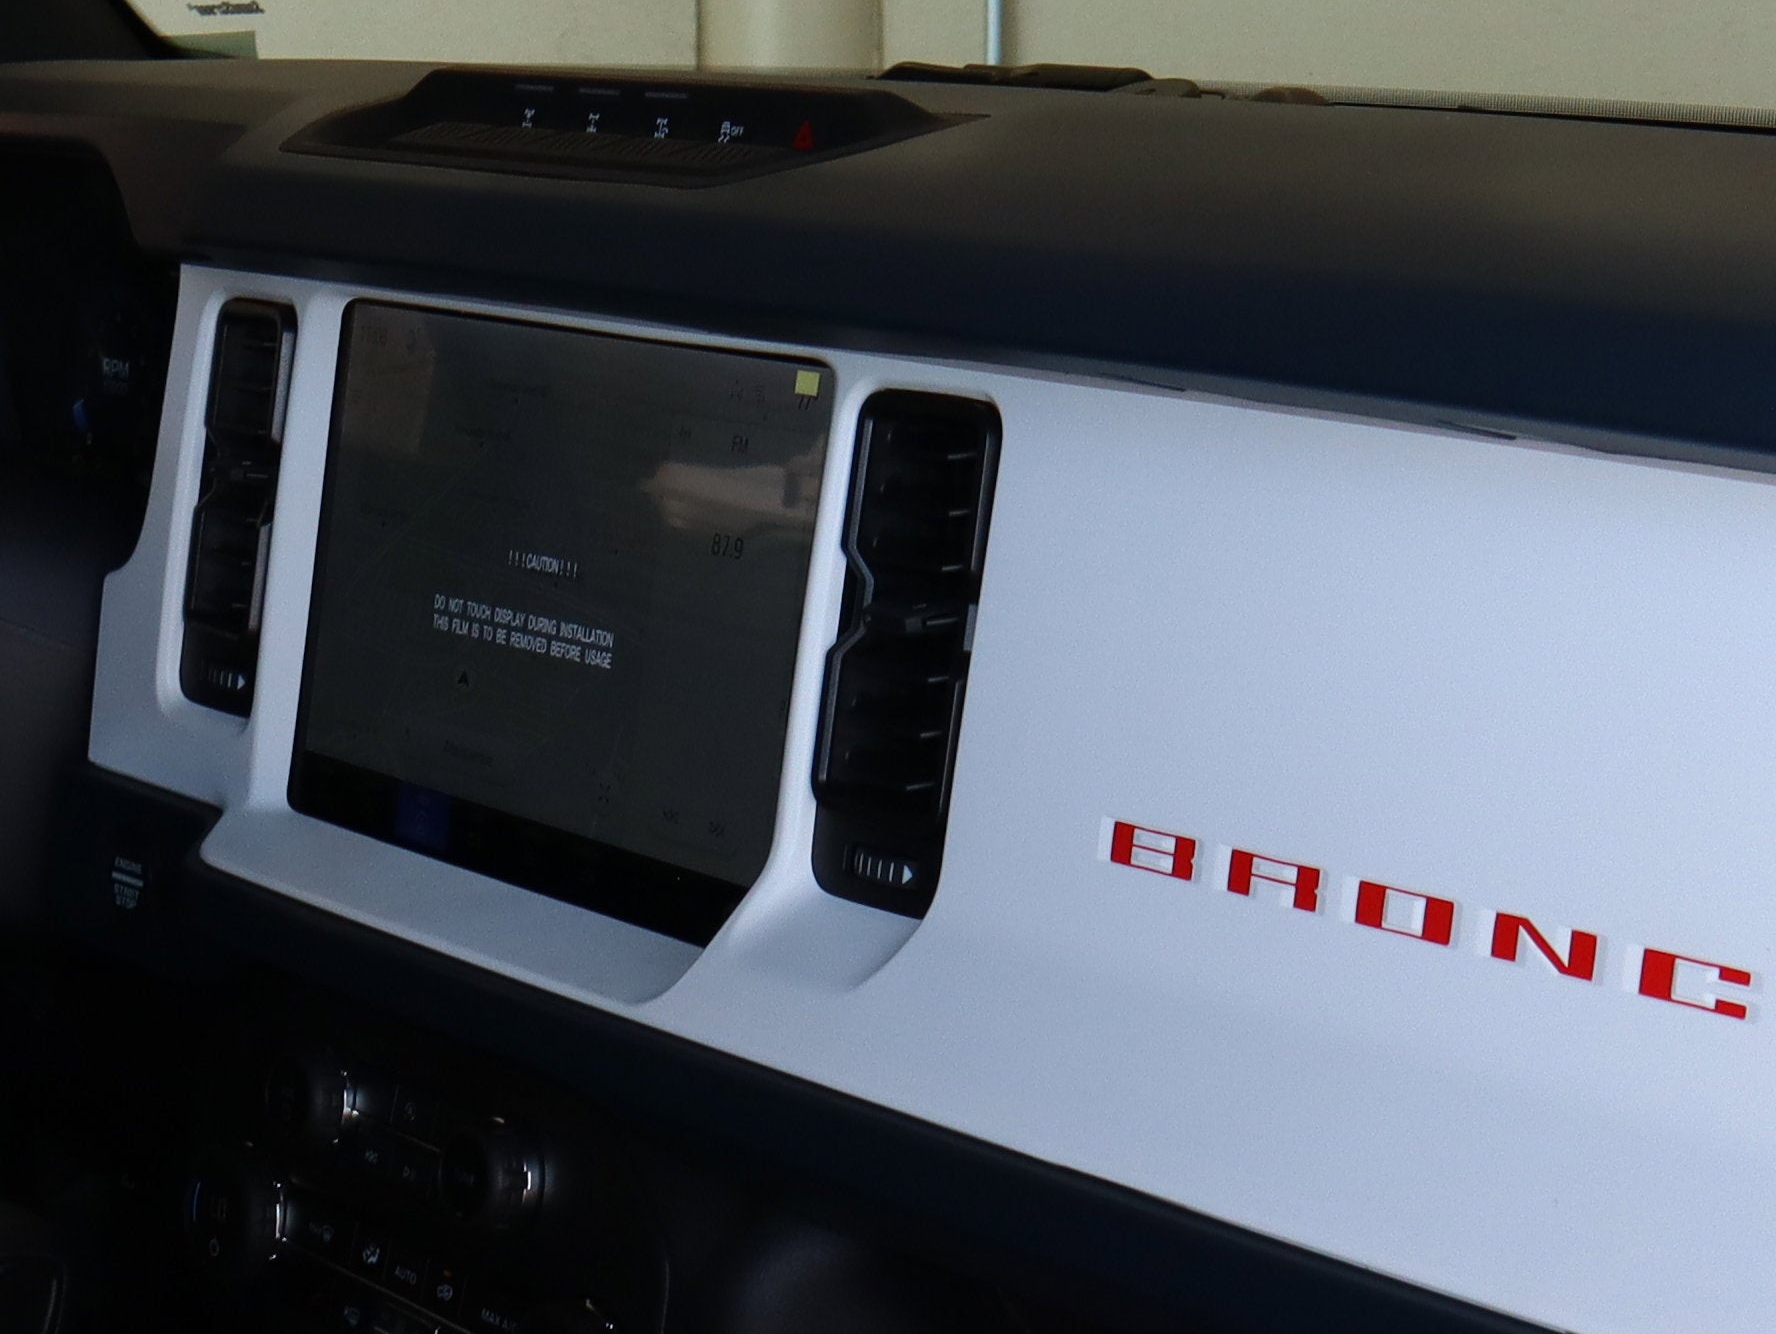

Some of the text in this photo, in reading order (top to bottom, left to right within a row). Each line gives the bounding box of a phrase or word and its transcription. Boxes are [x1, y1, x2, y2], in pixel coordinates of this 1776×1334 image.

[711, 533, 744, 559] 87.9
[434, 594, 614, 648] DO NOT TOUCH DISPLAY DURING INSTALLATION
[433, 614, 613, 670] THIS FILM IS TO BE REMOVED BEFORE USAGE
[394, 1265, 417, 1285] AUTO
[480, 1307, 500, 1326] MAX
